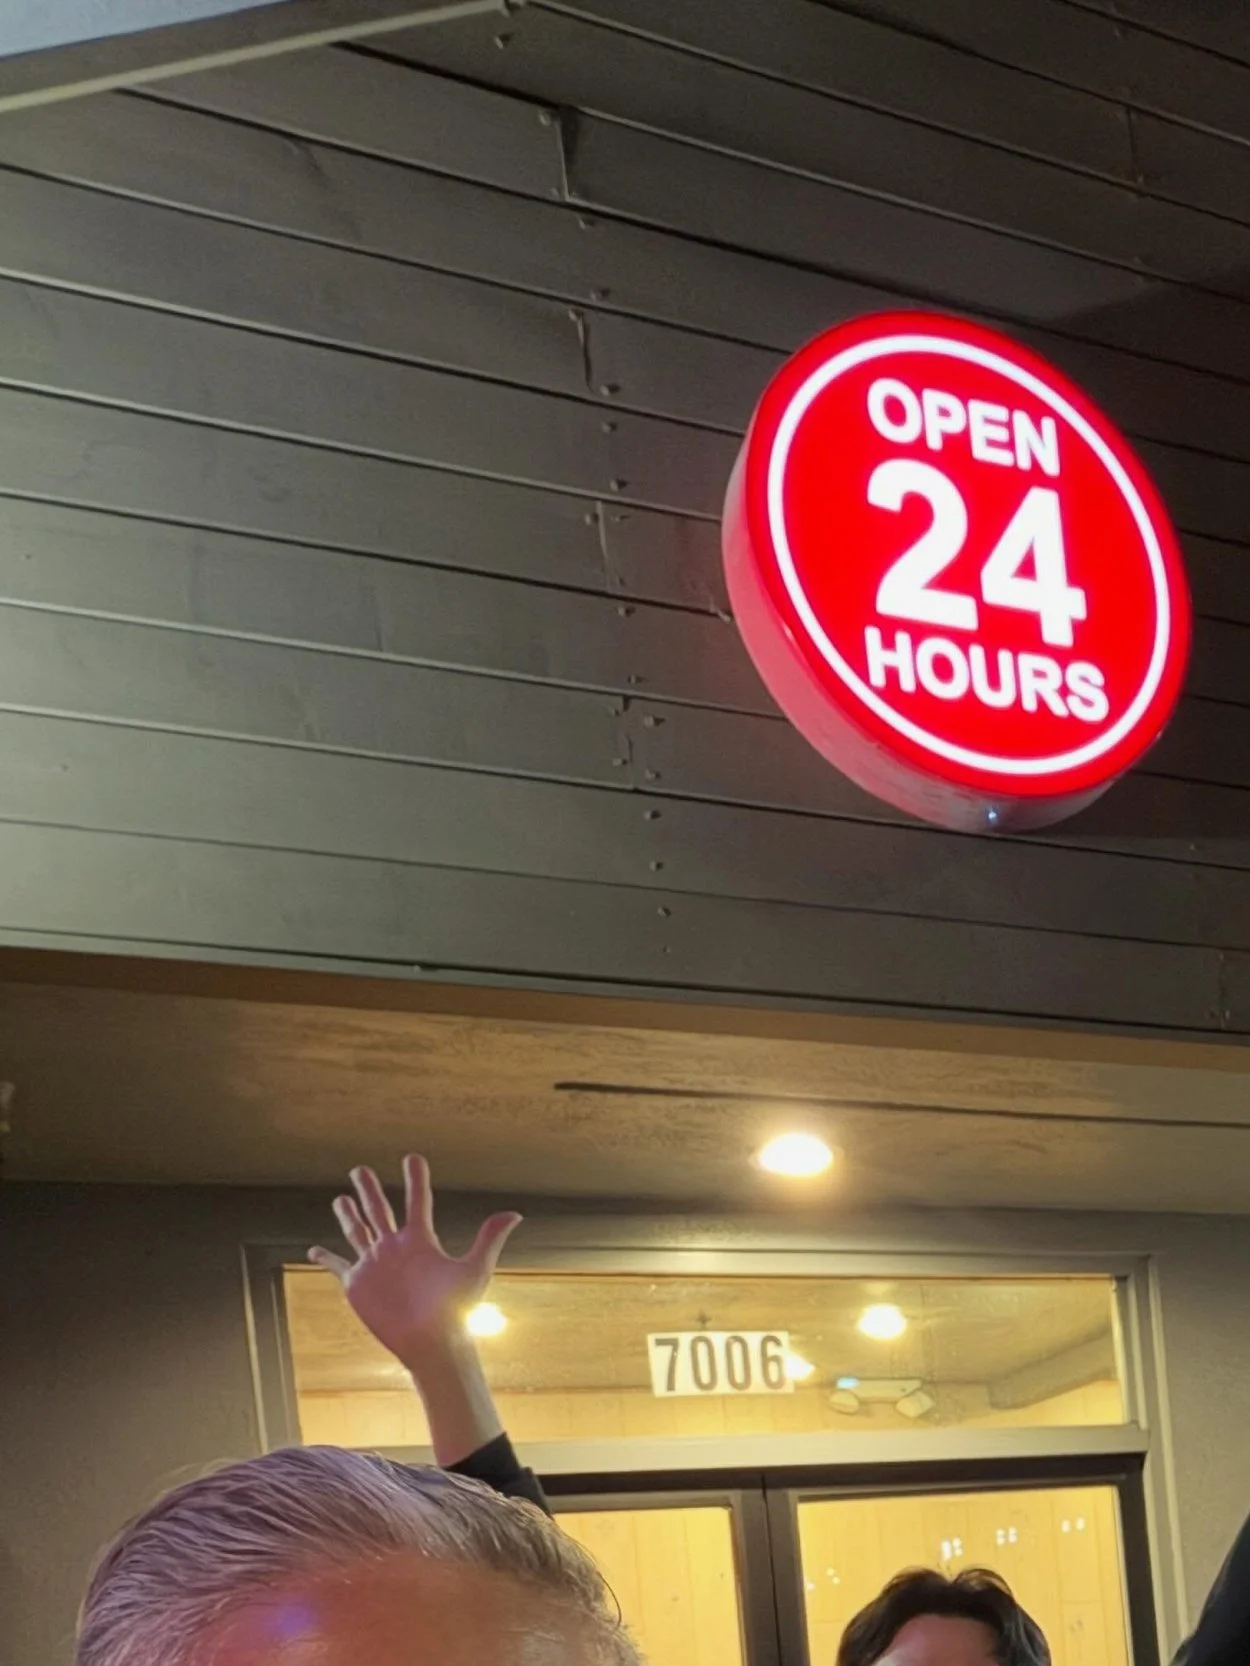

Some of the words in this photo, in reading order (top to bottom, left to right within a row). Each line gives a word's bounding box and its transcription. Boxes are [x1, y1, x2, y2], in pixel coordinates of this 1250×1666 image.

[867, 377, 1060, 477] OPEN
[866, 458, 1087, 647] 24
[864, 627, 1109, 723] HOURS
[654, 1334, 788, 1392] 7006
